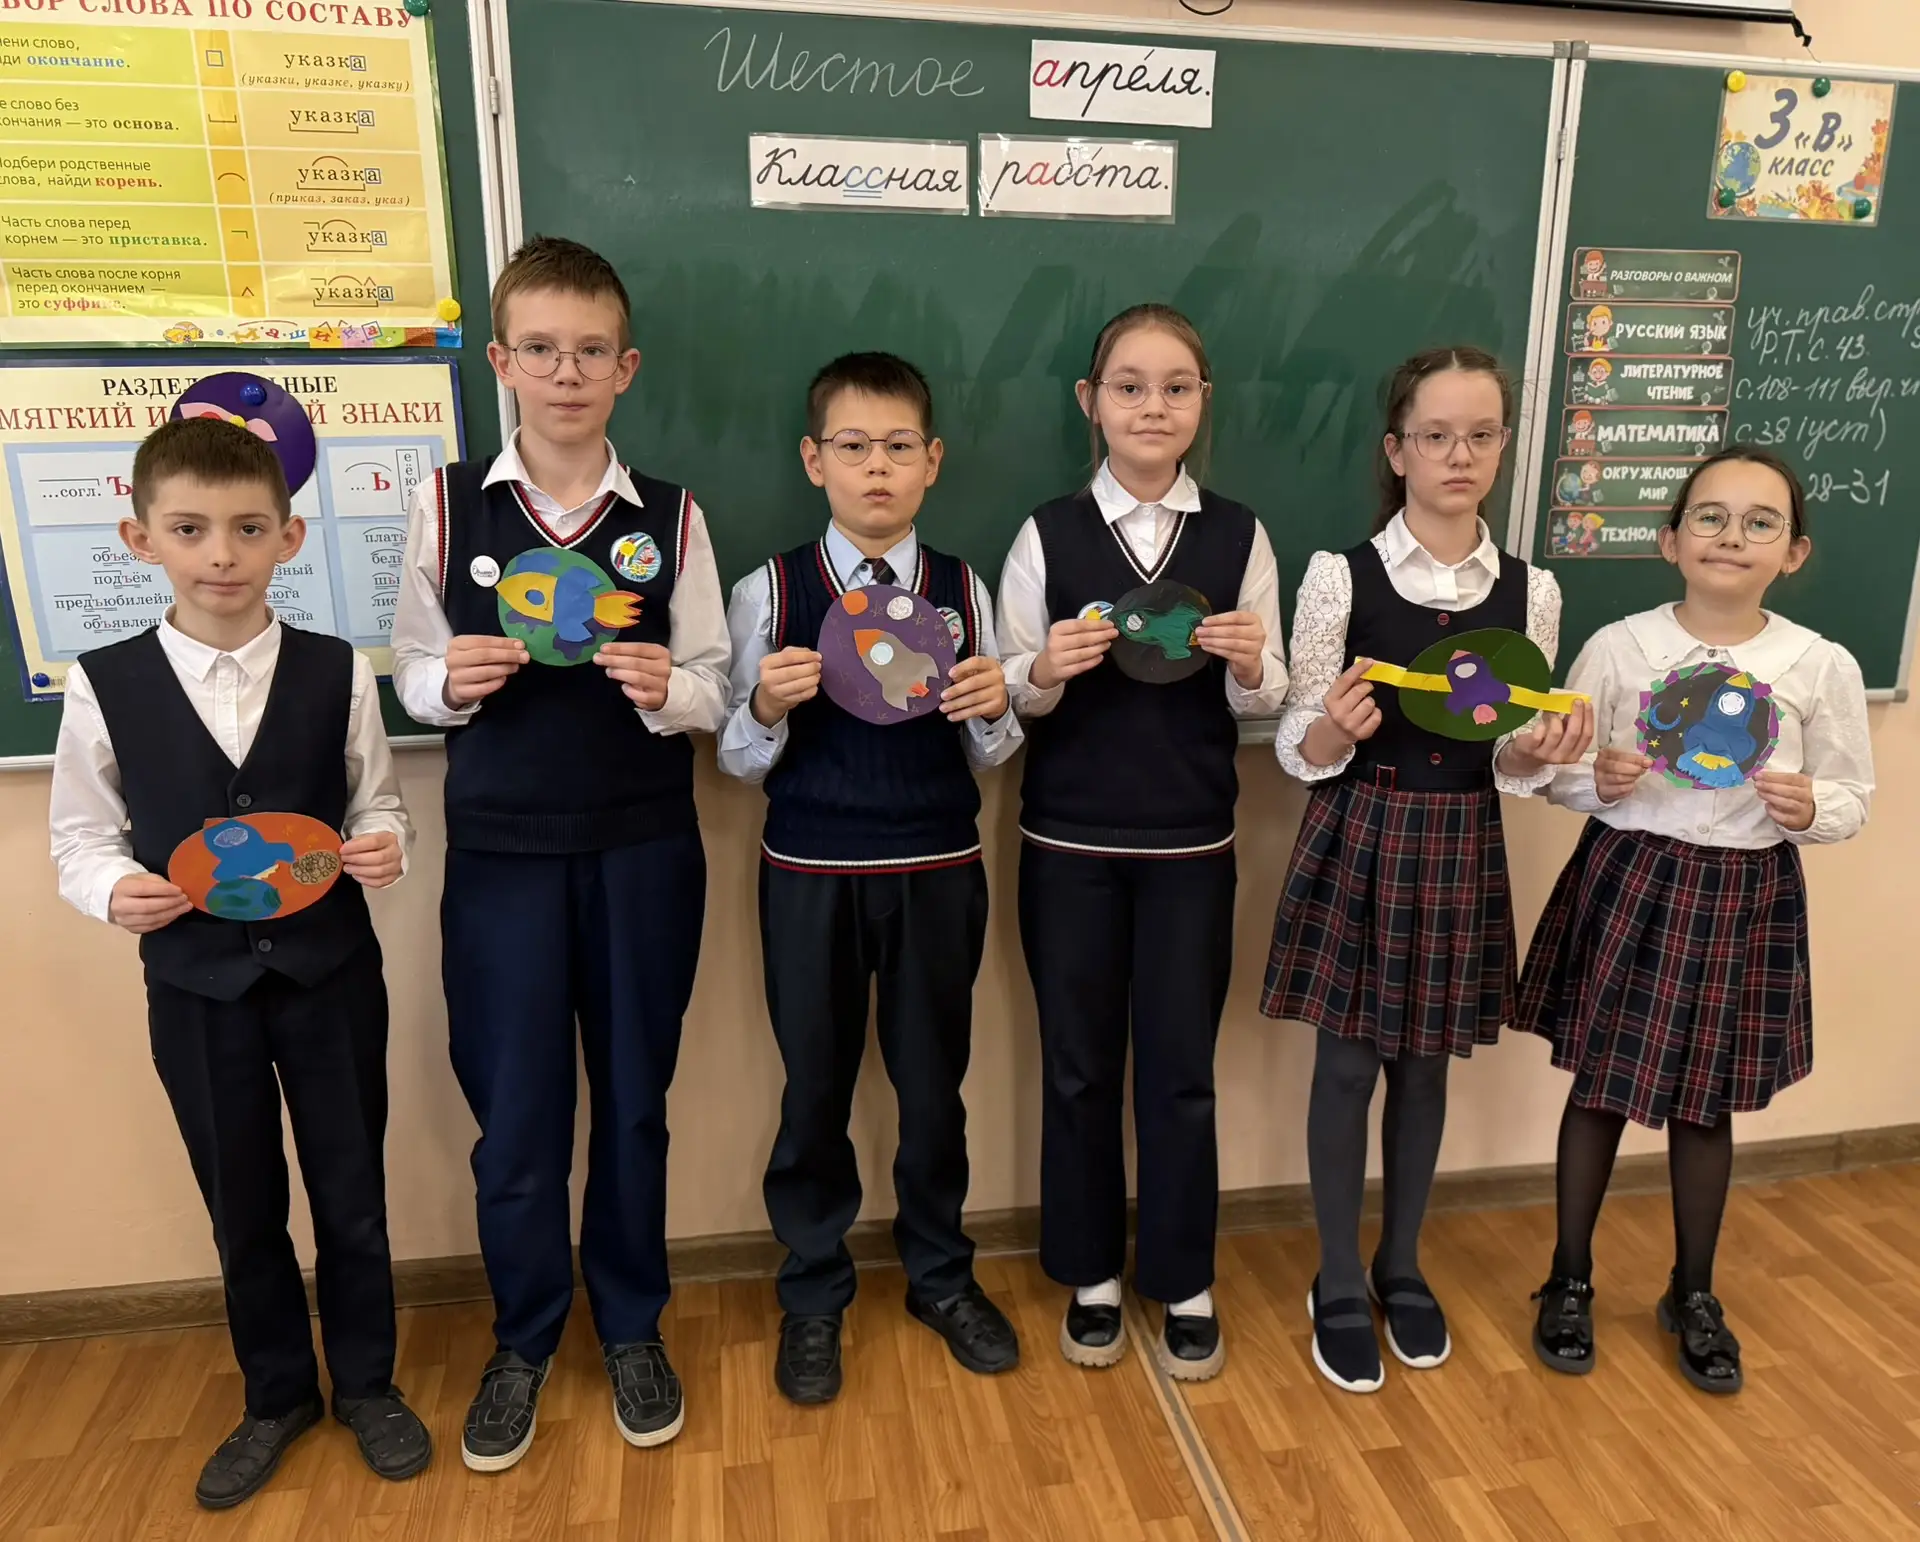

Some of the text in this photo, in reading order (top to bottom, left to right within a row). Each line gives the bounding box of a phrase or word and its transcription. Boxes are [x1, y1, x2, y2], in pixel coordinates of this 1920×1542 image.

[79, 0, 193, 17] СЛОВА
[208, 0, 253, 19] ПО
[265, 0, 413, 28] СОСТАВУ
[32, 38, 80, 51] слово,
[0, 54, 130, 68] ди окончание.
[284, 53, 365, 71] указка
[703, 27, 985, 97] Шестое
[11, 100, 52, 110] слово
[55, 98, 79, 111] без
[290, 109, 373, 125] указка
[1754, 88, 1798, 150] 3
[85, 119, 107, 129] это
[113, 119, 179, 131] основа.
[59, 158, 151, 172] родственные
[756, 147, 962, 192] Классная
[48, 173, 91, 187] найди
[95, 176, 163, 190] корень.
[298, 168, 380, 184] указка
[2, 216, 131, 231] Часть слова перед
[5, 235, 58, 247] корнем
[81, 235, 104, 246] это
[109, 235, 208, 248] приставка.
[308, 231, 386, 246] указка
[12, 267, 181, 282] Часть слова после корня
[1610, 269, 1733, 284] РАЗГОВОРЫ О ВАЖНОМ
[16, 283, 58, 295] перед
[61, 282, 145, 294] окончанием
[314, 285, 392, 301] указка
[18, 298, 40, 309] это
[1614, 322, 1729, 341] РУССКИЙ ЯЗЫК
[1619, 363, 1724, 380] ЛИТЕРАТУРНОЕ
[1646, 385, 1695, 401] ЧТЕНИЕ
[0, 401, 135, 430] МЯГКИЙ
[145, 406, 168, 428] И
[342, 402, 444, 425] ЗНАКИ
[1596, 423, 1720, 443] МАТЕМАТИКА
[1638, 486, 1669, 500] МИР
[365, 532, 407, 544] плать
[1600, 526, 1657, 542] ТЕХНОЛ
[92, 550, 141, 563] объез
[372, 552, 404, 564] бель
[273, 563, 314, 576] зный
[93, 571, 153, 587] подъём
[55, 592, 174, 611] предъюбилейн
[264, 589, 300, 600] ьюга
[372, 597, 398, 607] лис
[83, 617, 162, 630] объявлен
[277, 612, 314, 622] ьяна
